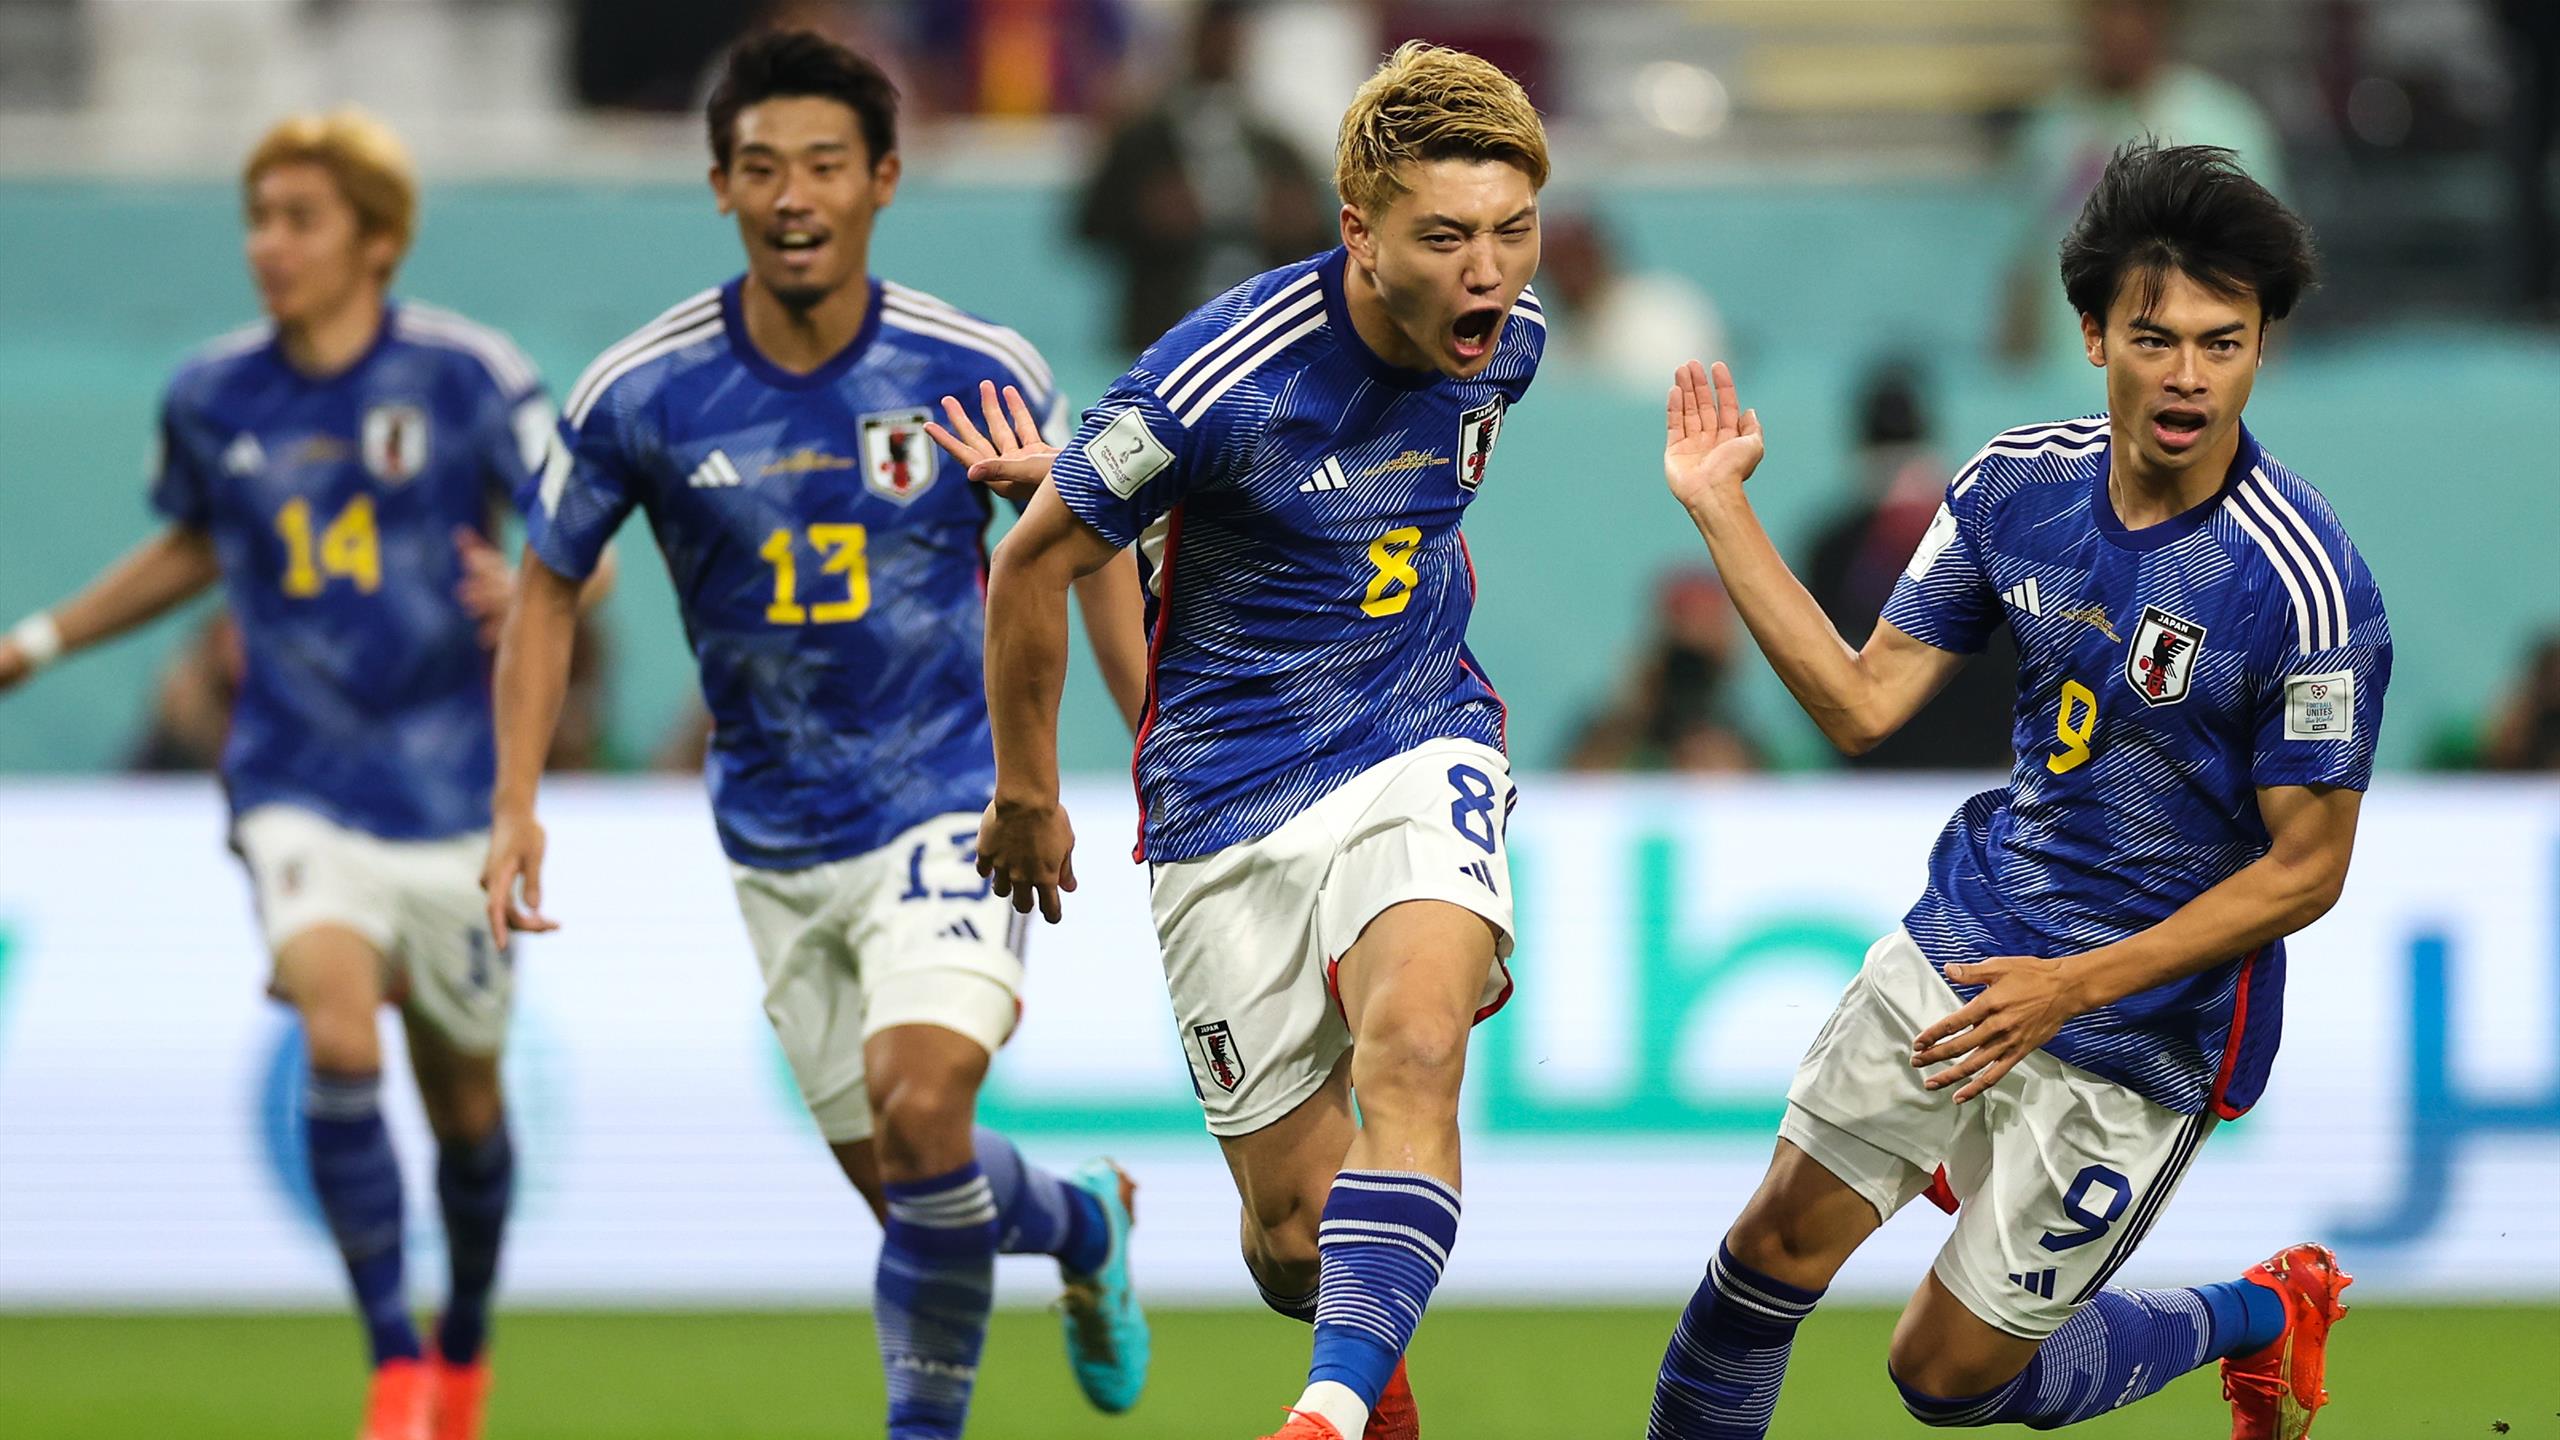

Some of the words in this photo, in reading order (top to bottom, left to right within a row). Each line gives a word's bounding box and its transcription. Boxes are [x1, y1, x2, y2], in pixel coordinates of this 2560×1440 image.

[1473, 403, 1496, 420] JAPAN
[274, 493, 382, 599] 14
[760, 522, 872, 625] 13
[1360, 526, 1422, 618] 8
[2157, 614, 2190, 634] JAPAN
[2046, 679, 2098, 775] 9
[2306, 708, 2333, 717] UNITES
[1447, 763, 1496, 855] 8
[900, 832, 992, 902] 13
[1200, 1024, 1220, 1033] JAPAN
[2038, 1163, 2133, 1253] 9
